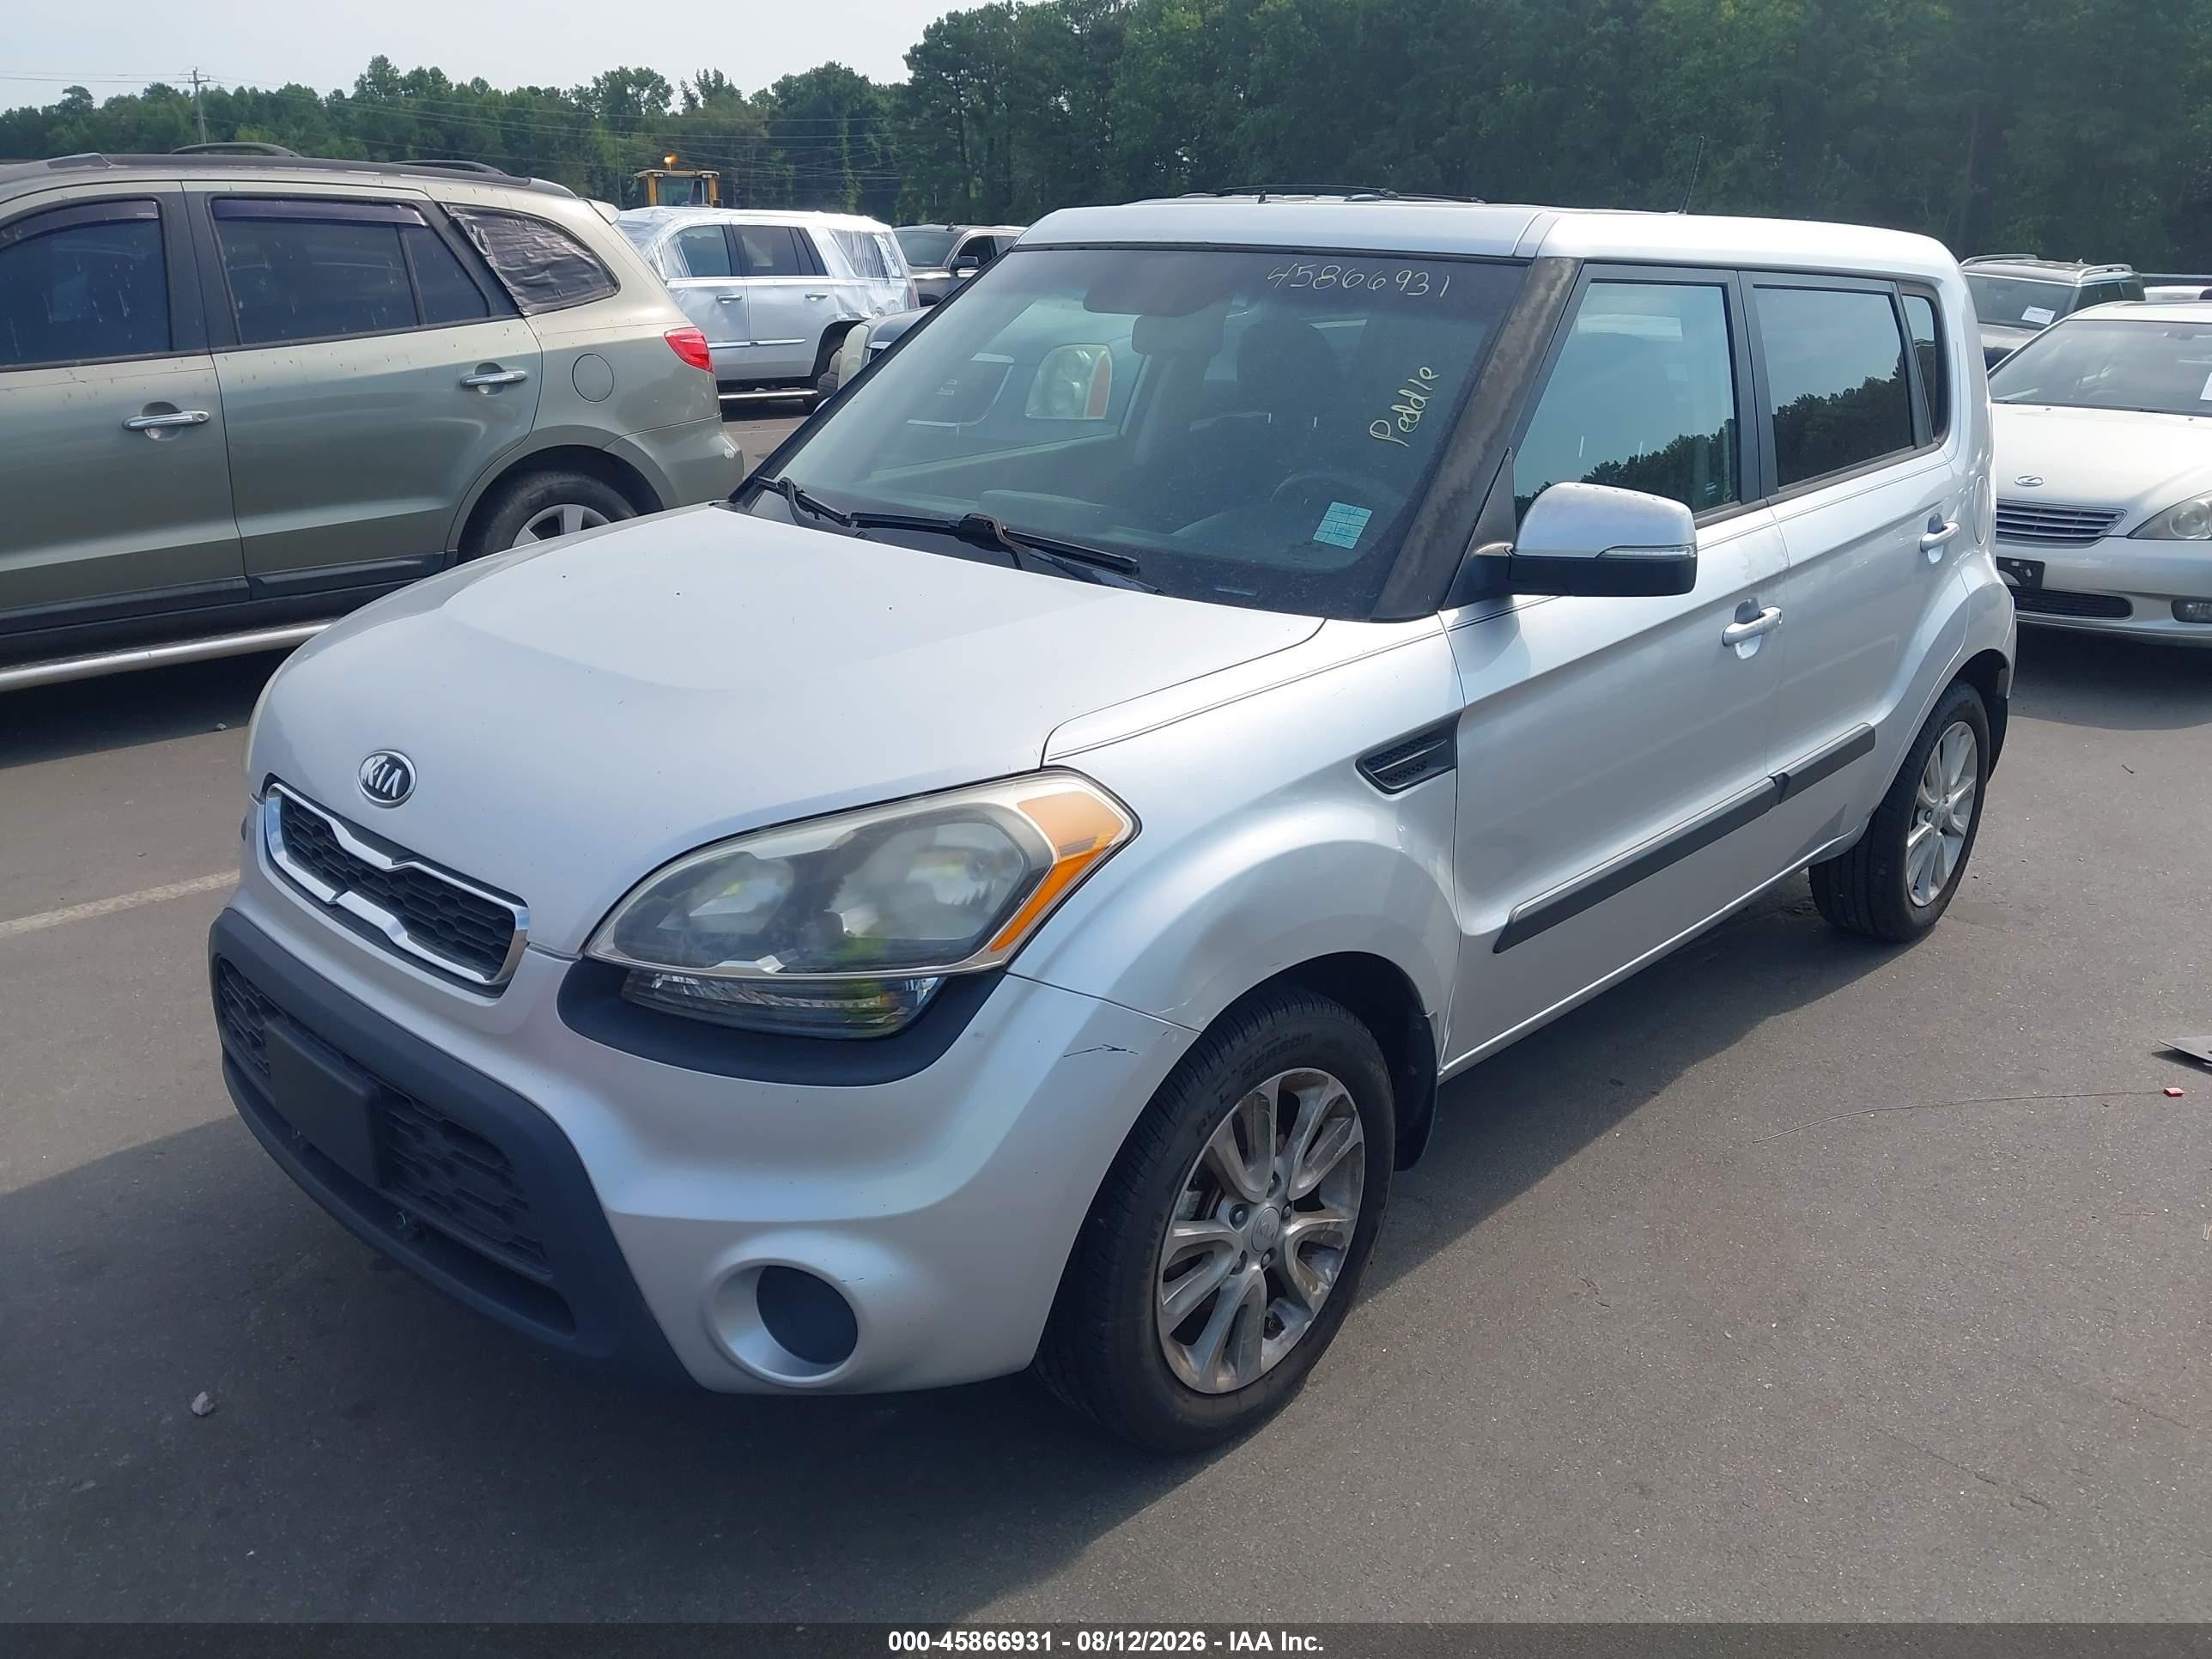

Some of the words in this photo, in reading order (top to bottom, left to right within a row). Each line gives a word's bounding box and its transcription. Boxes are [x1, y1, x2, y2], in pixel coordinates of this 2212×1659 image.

[1267, 263, 1450, 298] 45866931
[1369, 366, 1440, 447] Peddle
[367, 755, 403, 799] KIA
